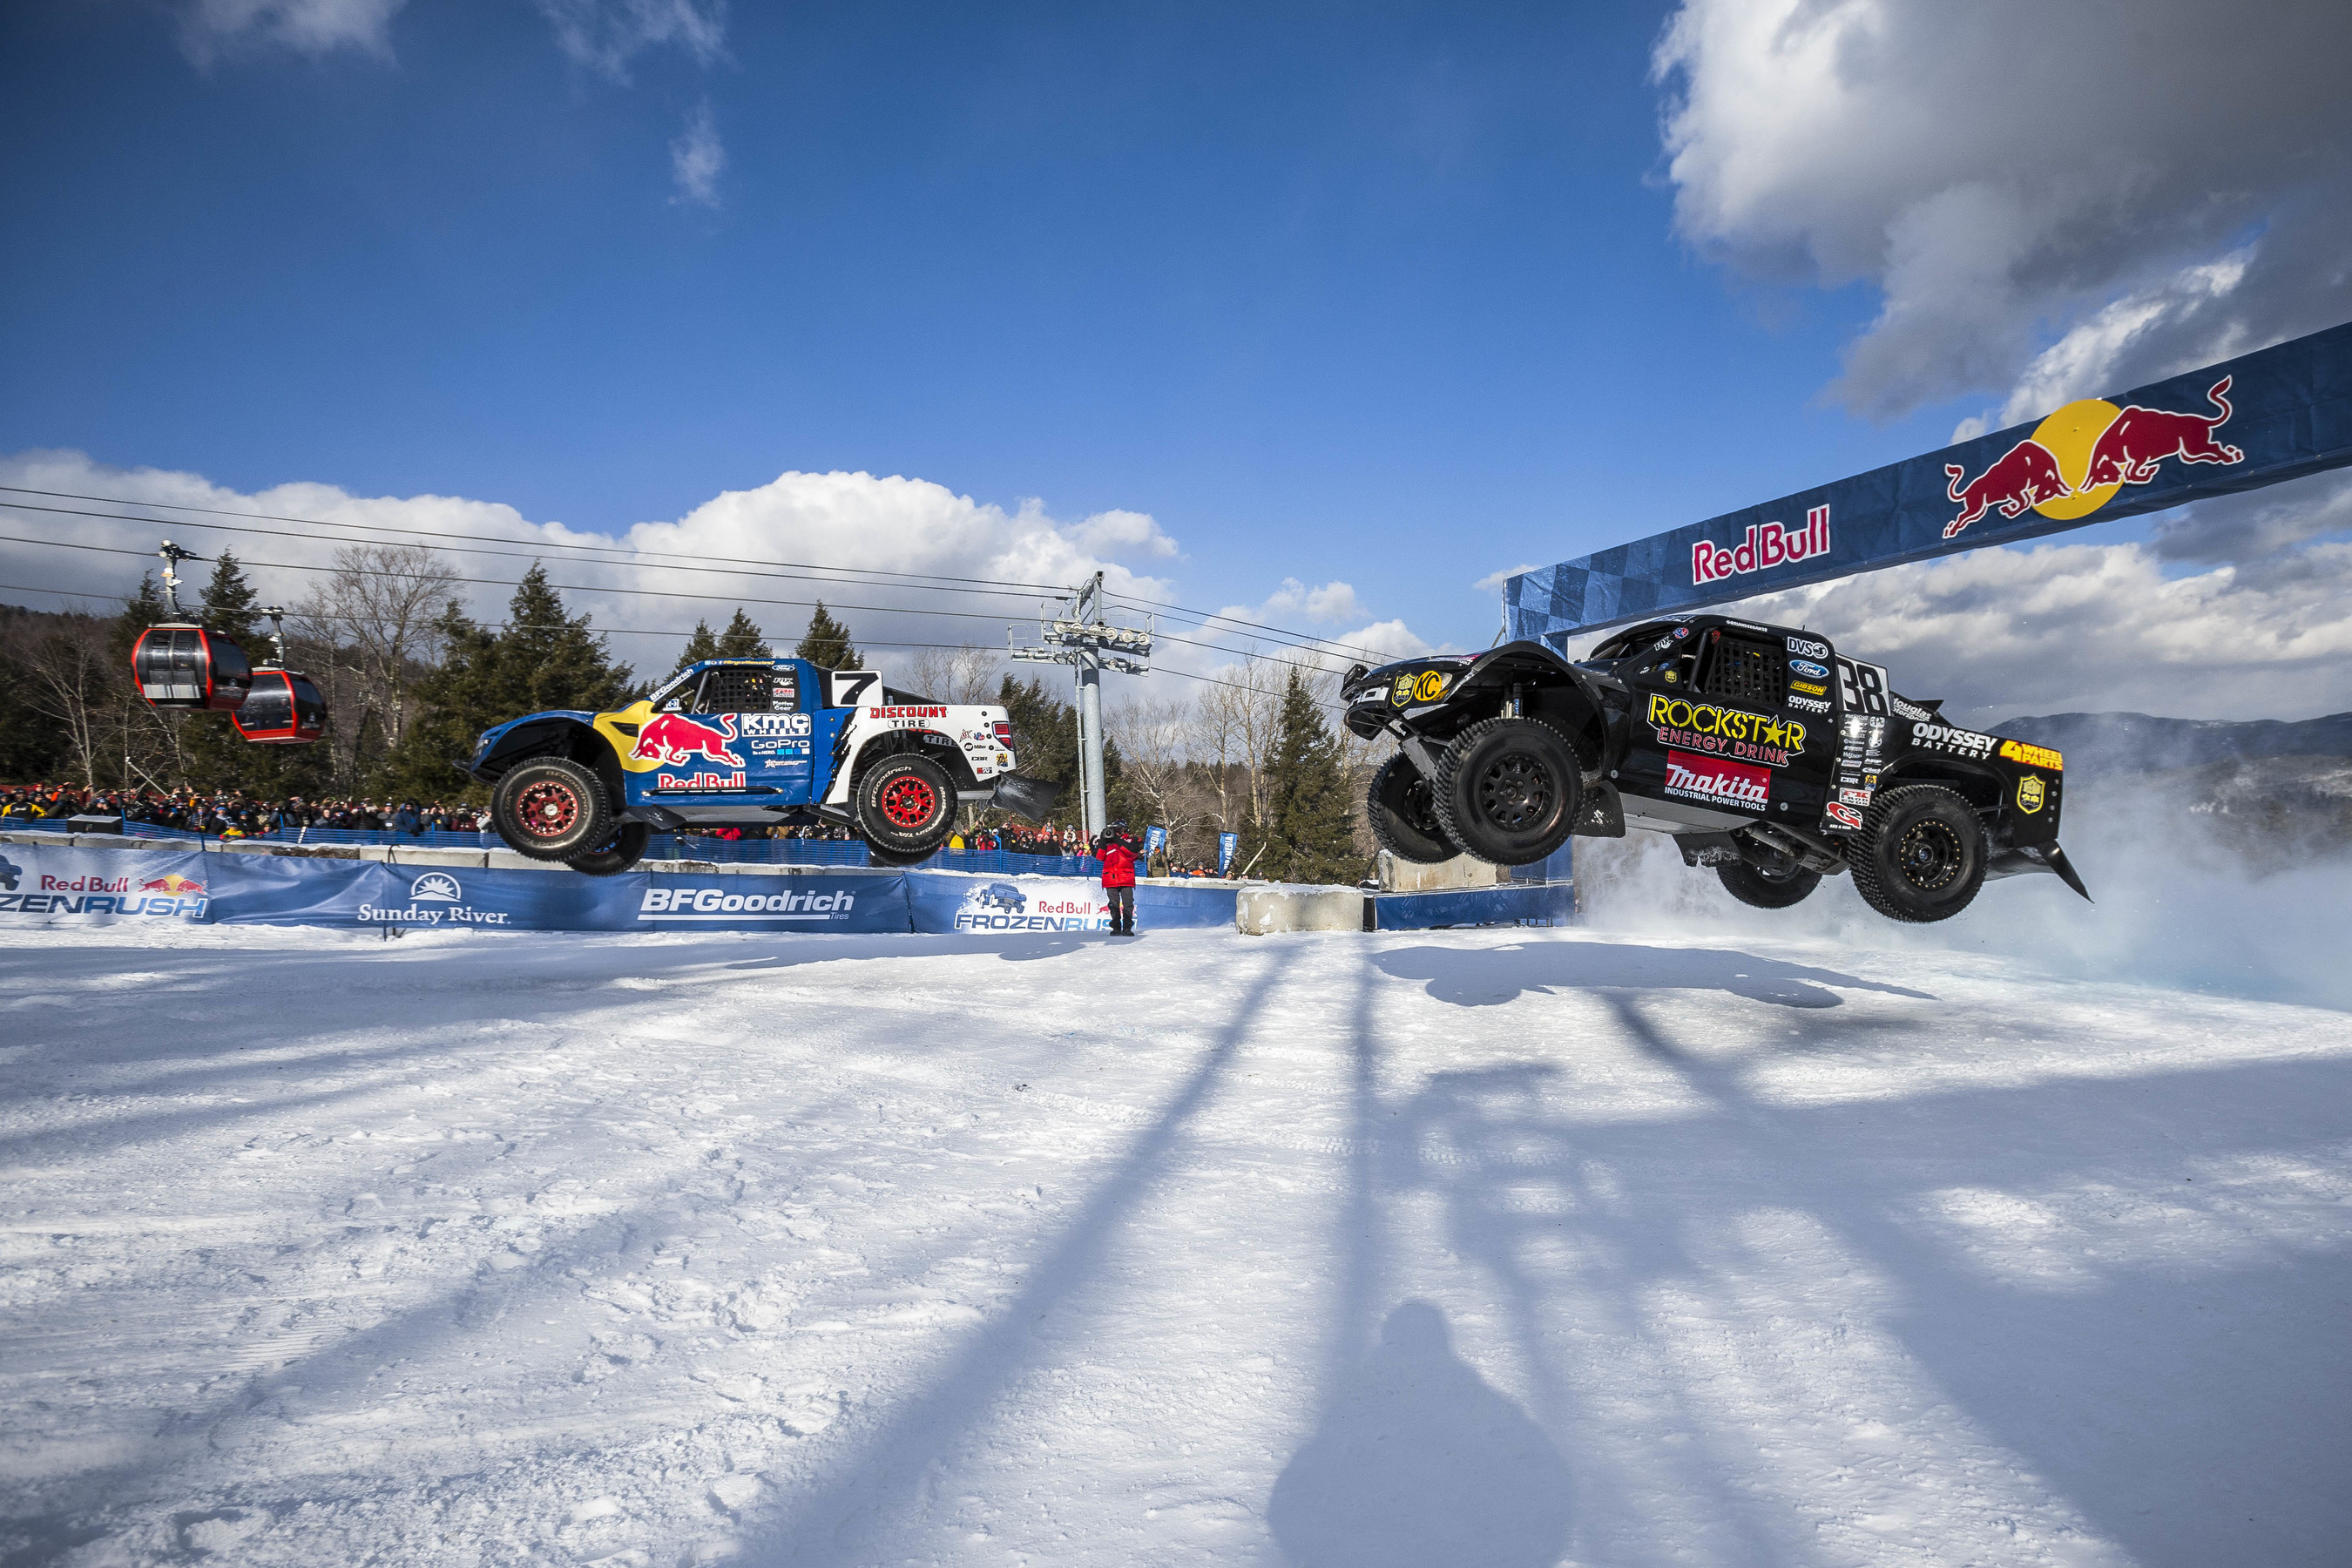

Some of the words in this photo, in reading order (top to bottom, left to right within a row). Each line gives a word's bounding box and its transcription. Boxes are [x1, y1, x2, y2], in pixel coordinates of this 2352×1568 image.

[1693, 524, 1757, 585] Red
[1760, 504, 1830, 570] Bull
[1787, 636, 1814, 657] DVS
[649, 668, 693, 701] BFGoodrich
[835, 672, 879, 705] 7
[1416, 672, 1440, 699] KC
[1794, 680, 1826, 693] GIBSON
[1835, 656, 1890, 714] 38
[870, 706, 948, 719] DISCOUNT
[1788, 695, 1831, 710] ODYSSEY
[1788, 703, 1828, 713] BATTERY
[751, 739, 811, 749] GoPro
[1659, 726, 1728, 753] ENERGY
[1734, 741, 1788, 764] DRINK
[1912, 722, 1997, 752] ODYSSEY
[1911, 738, 1990, 760] BATTERY
[1999, 740, 2023, 763] 4
[2022, 743, 2063, 761] WHEEL
[2022, 753, 2064, 772] PARTS
[658, 772, 702, 787] Red
[704, 771, 747, 787] Bull
[871, 766, 912, 808] BFGoodrich
[545, 770, 590, 819] BFGoodrich
[1665, 786, 1711, 801] INDUSTRIAL
[1712, 796, 1740, 808] POWER
[1740, 801, 1766, 812] TOOLS
[41, 875, 85, 892] Red
[89, 876, 129, 893] Bull
[640, 888, 855, 912] BFGoodrich
[1038, 901, 1064, 914] Red
[1066, 902, 1091, 915] Bull
[357, 903, 444, 925] Sunday
[448, 906, 509, 924] River
